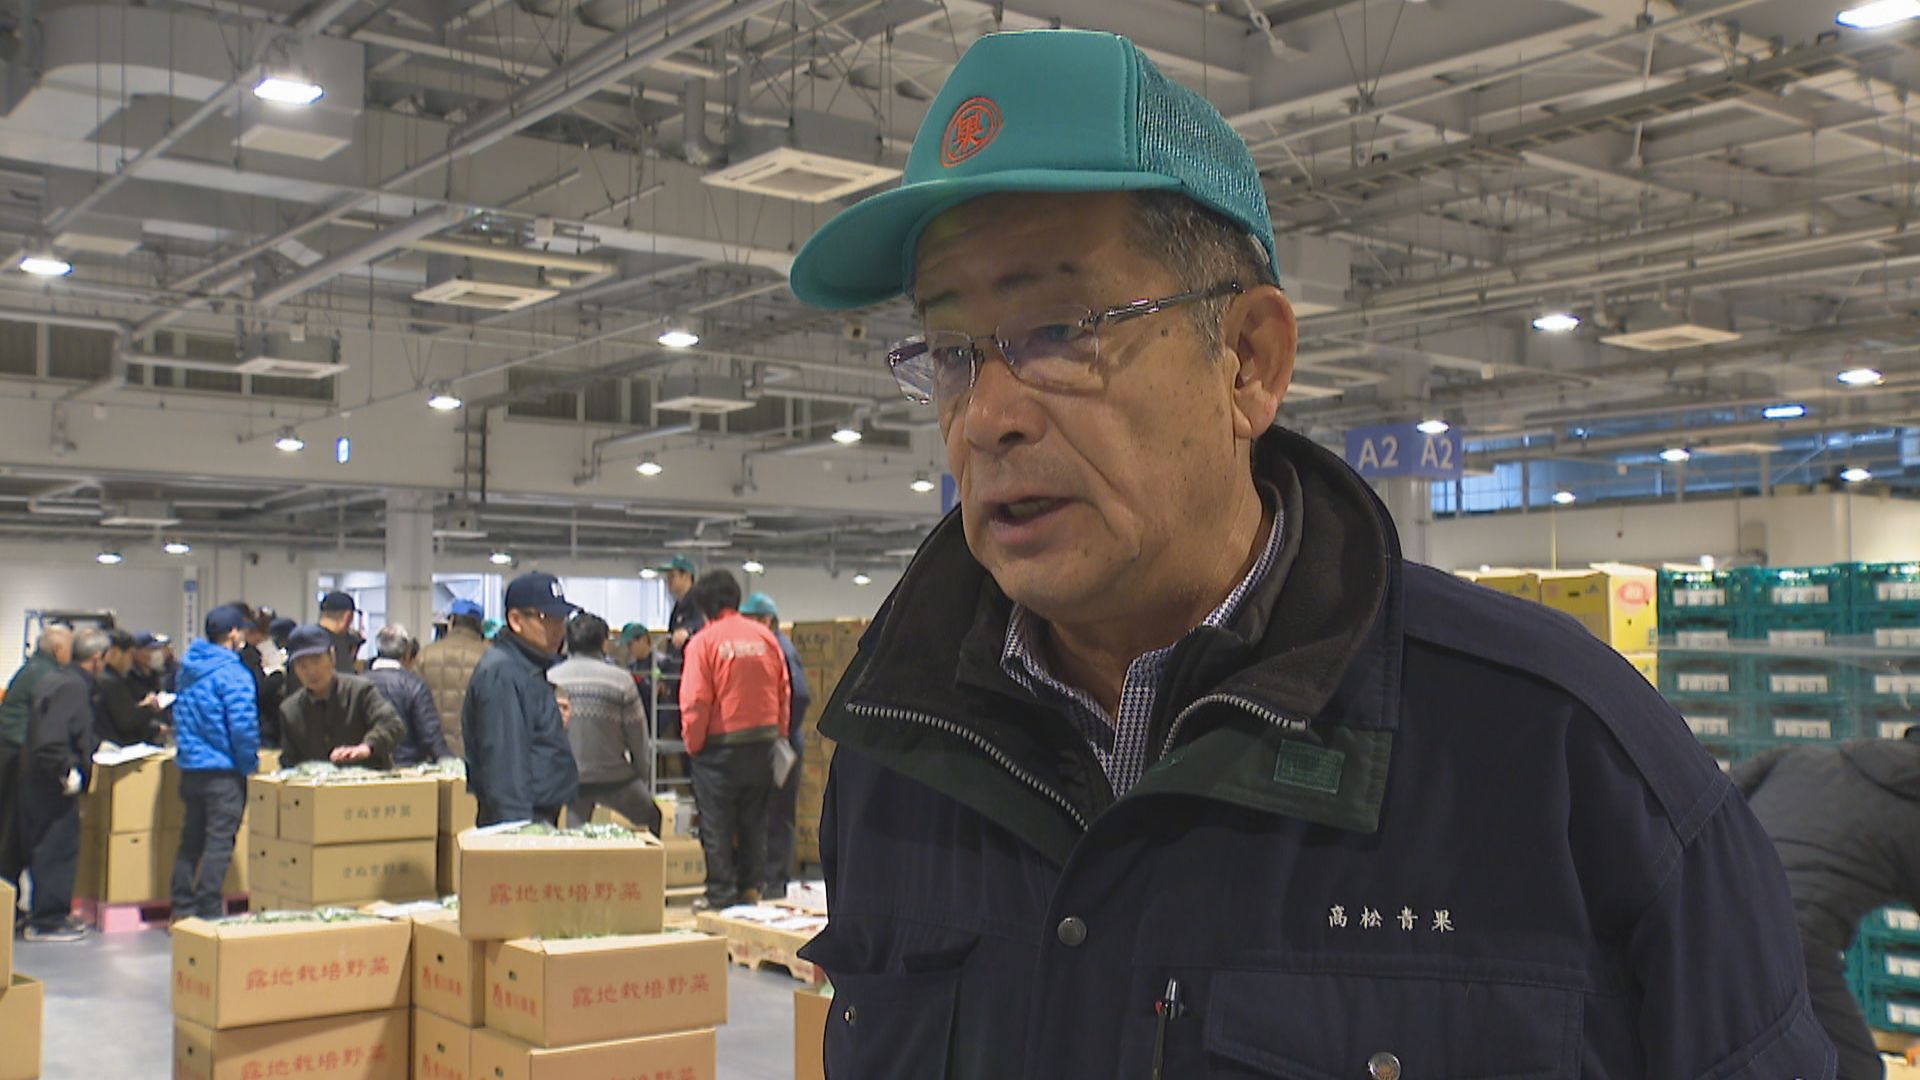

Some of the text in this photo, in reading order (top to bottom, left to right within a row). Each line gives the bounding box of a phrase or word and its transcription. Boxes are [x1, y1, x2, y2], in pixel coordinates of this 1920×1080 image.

[1359, 435, 1399, 470] A2
[1421, 436, 1454, 470] A2
[489, 882, 641, 905] 露地栽培野菜
[246, 956, 390, 991] 露地栽培野菜
[572, 973, 710, 1008] 露地栽培野菜
